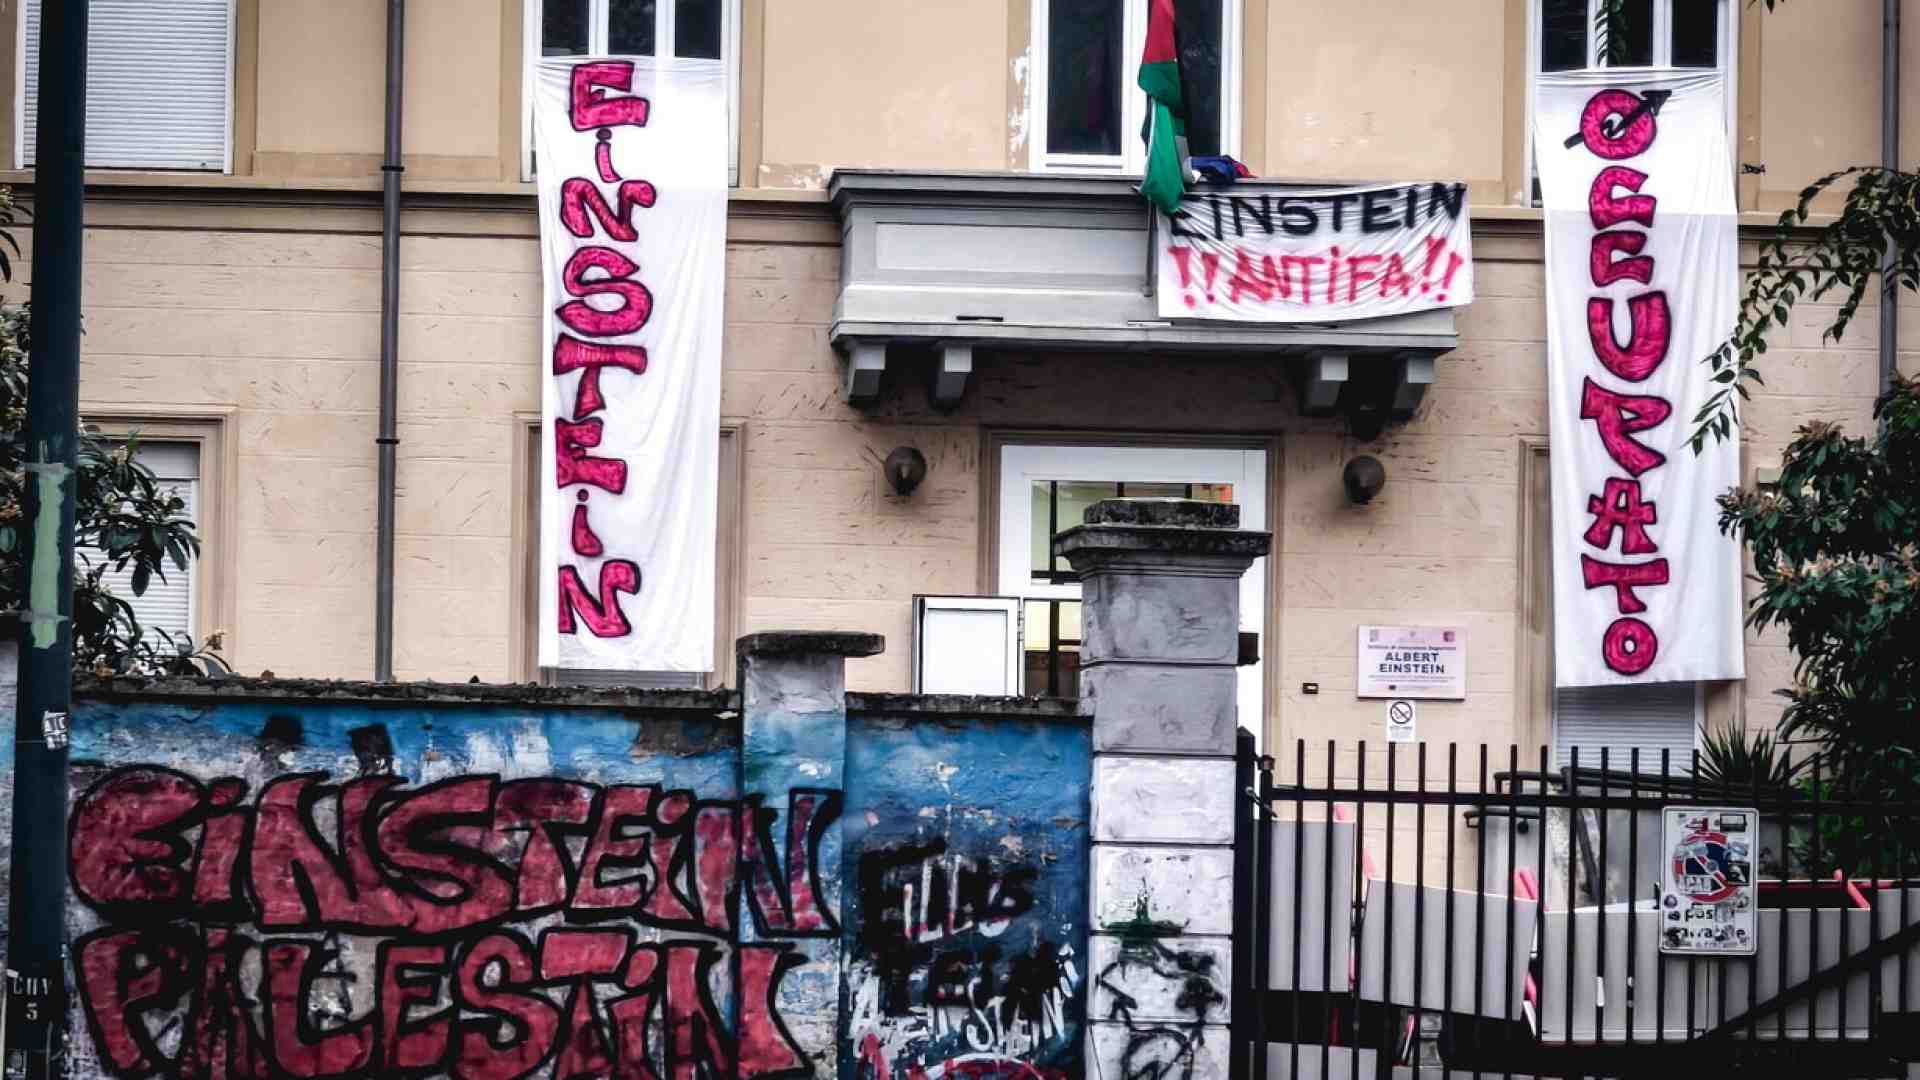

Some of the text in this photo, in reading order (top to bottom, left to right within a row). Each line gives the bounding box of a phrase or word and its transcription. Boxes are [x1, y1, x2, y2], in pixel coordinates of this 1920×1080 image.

[1385, 651, 1440, 662] ALBERT
[1379, 663, 1445, 674] EINSTEIN
[26, 1002, 38, 1020] 5
